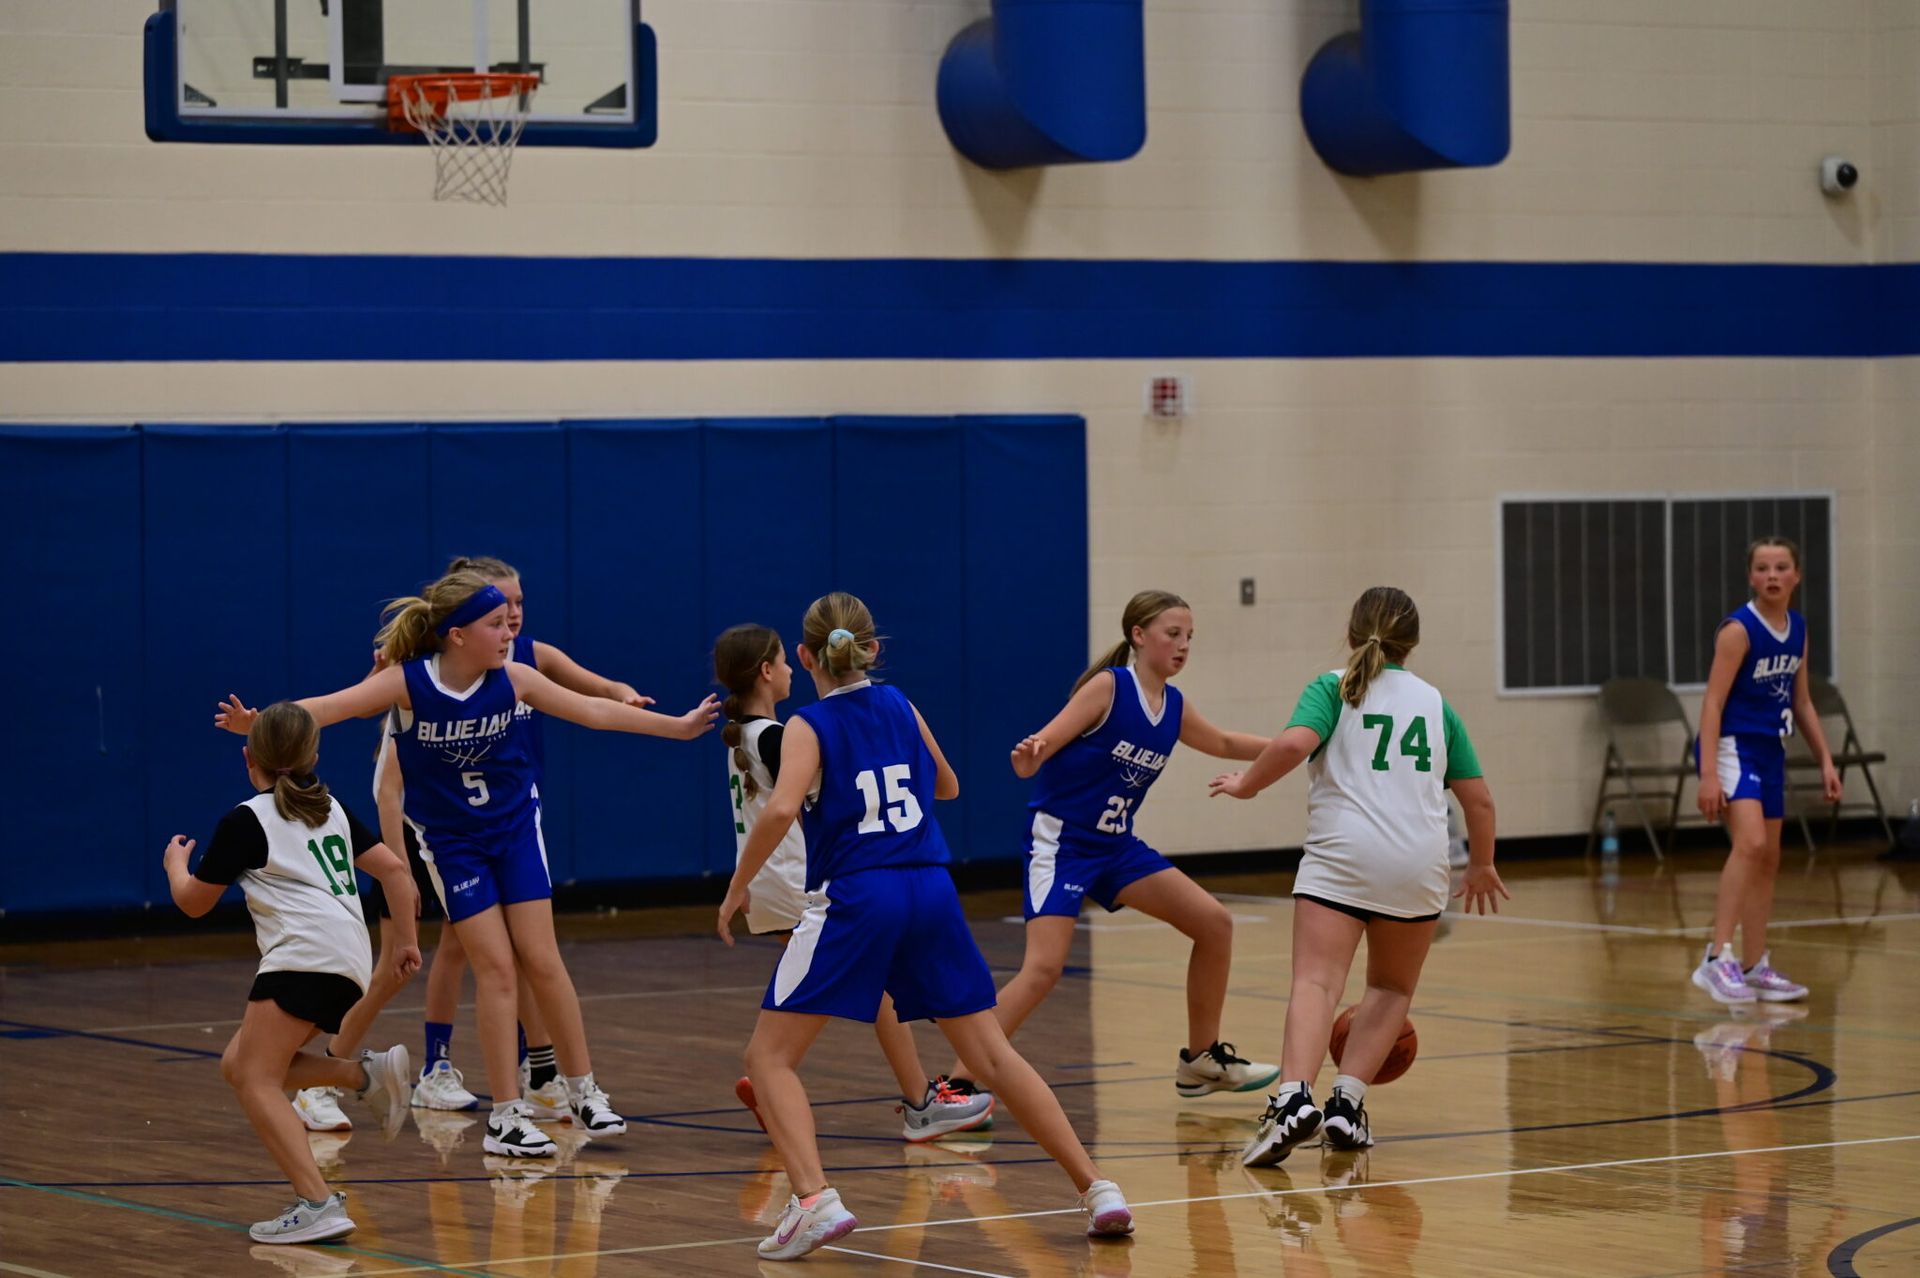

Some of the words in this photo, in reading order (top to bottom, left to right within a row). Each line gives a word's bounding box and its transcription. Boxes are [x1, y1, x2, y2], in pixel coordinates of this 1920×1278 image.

[417, 709, 512, 742] BLUEJAY
[1362, 714, 1431, 772] 74
[462, 771, 490, 807] 5
[855, 764, 924, 834] 15
[307, 834, 356, 896] 19
